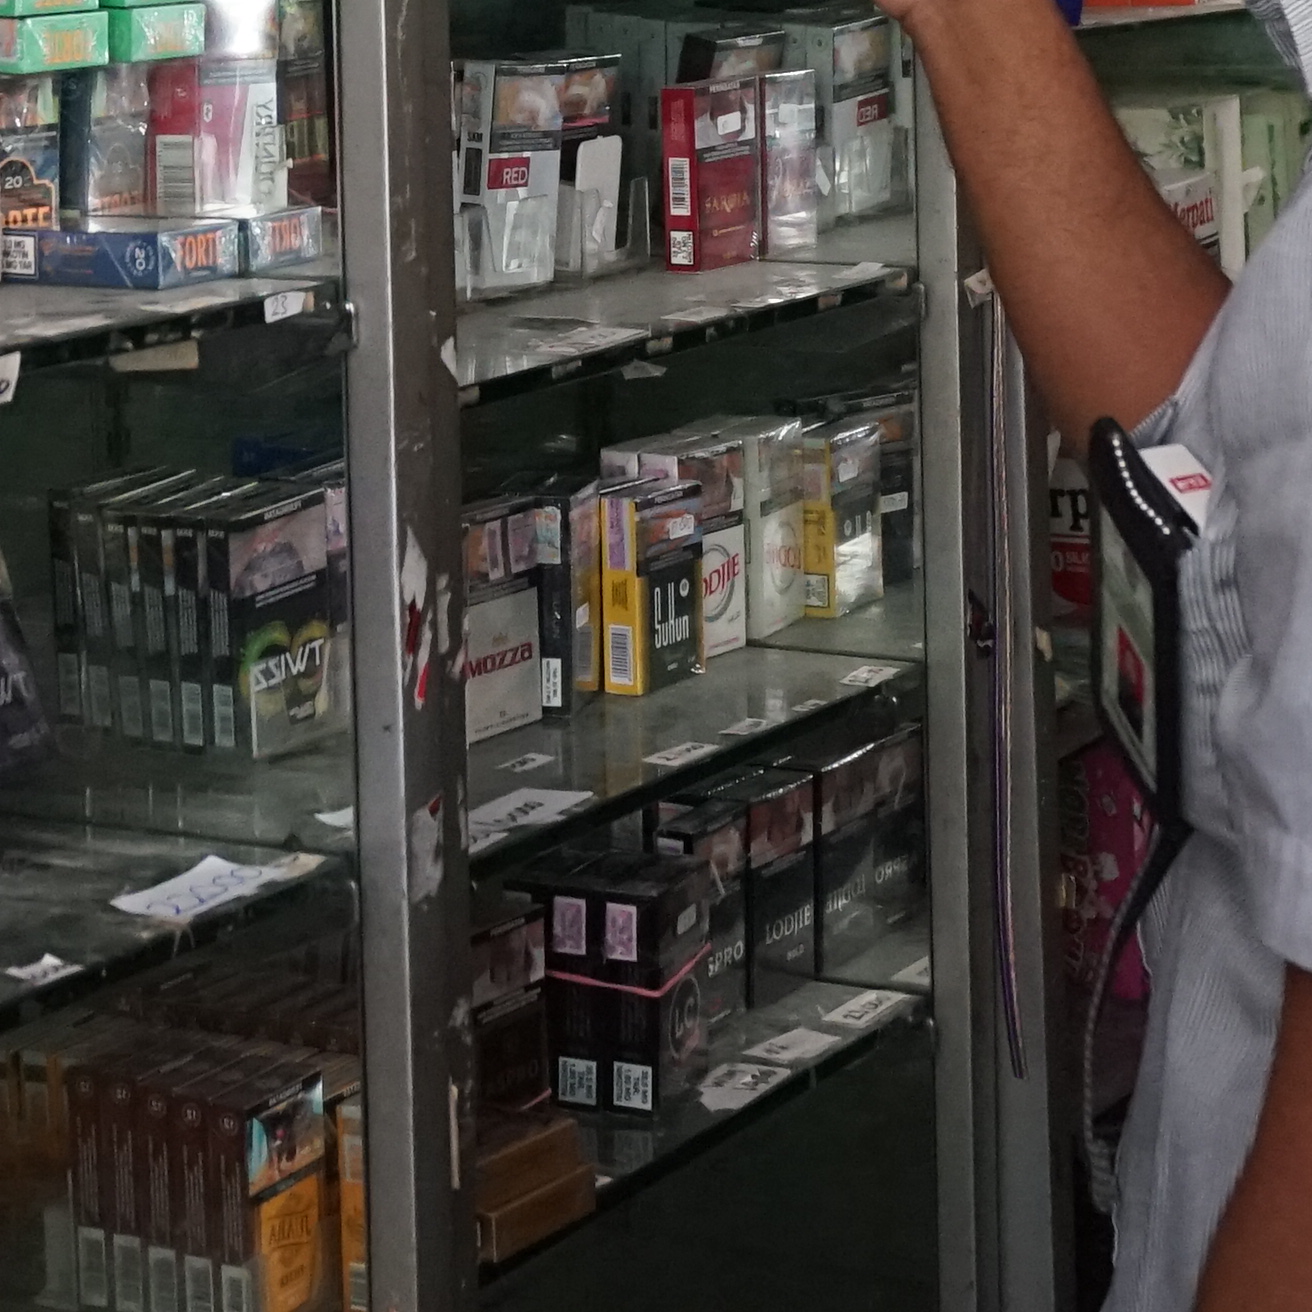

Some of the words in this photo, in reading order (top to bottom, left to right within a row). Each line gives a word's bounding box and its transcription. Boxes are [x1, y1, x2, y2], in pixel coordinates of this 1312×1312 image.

[4, 175, 24, 189] 20
[502, 166, 528, 185] RED
[270, 295, 288, 317] 23
[765, 904, 813, 946] LODJIE
[708, 939, 745, 979] SPRO
